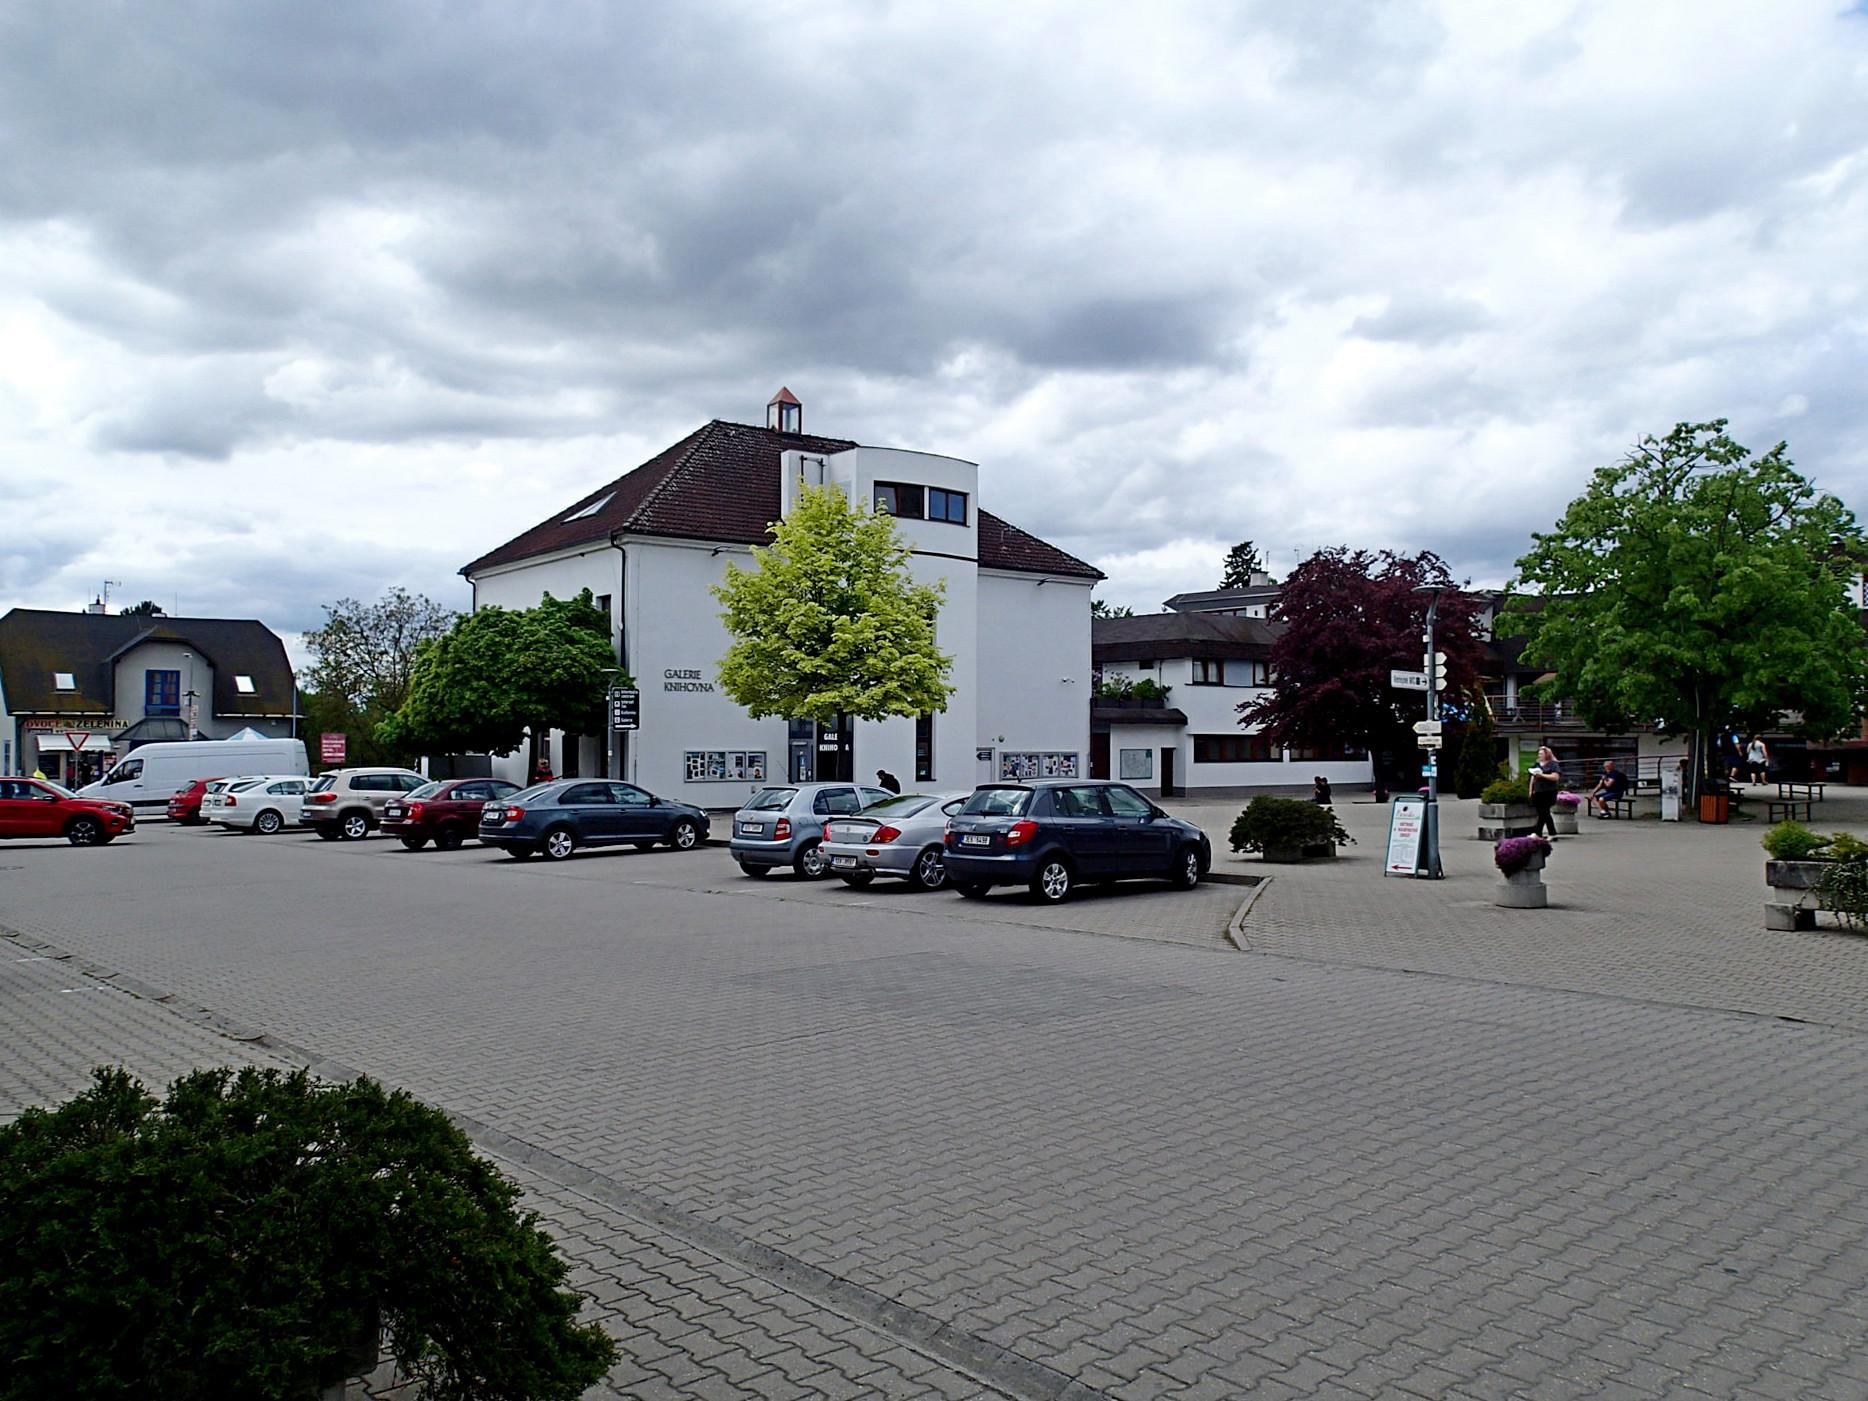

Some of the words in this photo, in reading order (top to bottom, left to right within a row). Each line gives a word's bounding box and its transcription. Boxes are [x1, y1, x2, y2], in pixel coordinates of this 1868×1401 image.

[664, 669, 701, 679] GALERIE
[664, 682, 715, 692] KNIHOVNA
[26, 720, 61, 728] OVOCE
[76, 720, 129, 729] ZELENINA
[819, 743, 850, 751] KNIHOA
